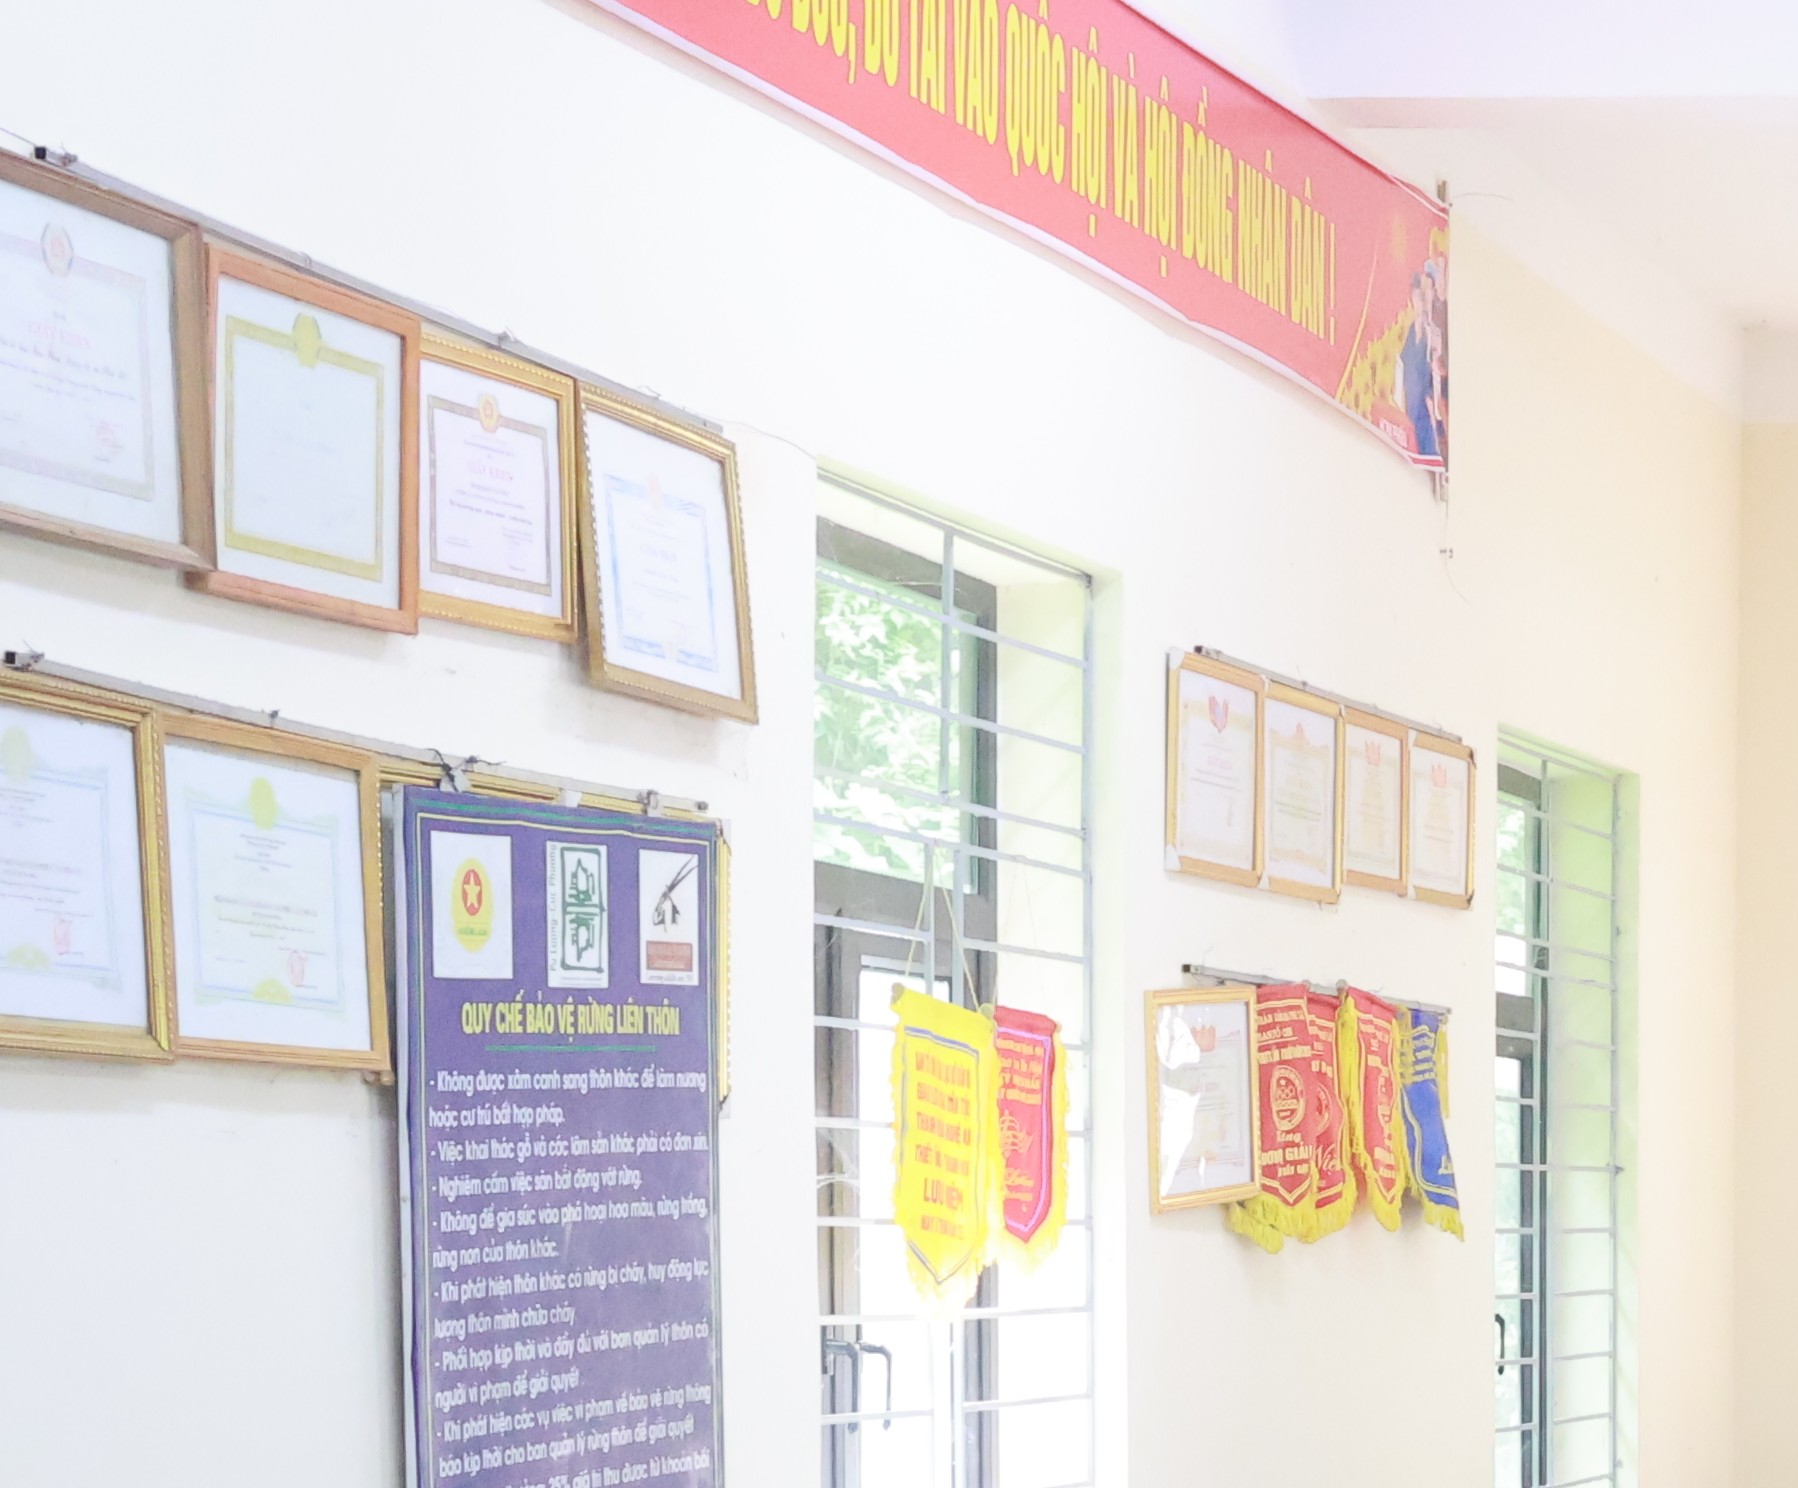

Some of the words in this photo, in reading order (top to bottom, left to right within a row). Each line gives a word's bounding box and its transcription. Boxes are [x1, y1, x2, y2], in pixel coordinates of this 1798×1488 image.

[1004, 0, 1066, 185] QUỐC
[1070, 25, 1108, 239] HỘI
[1112, 51, 1139, 229] VÀ
[1143, 74, 1178, 279] HỘI
[1181, 85, 1234, 285] ĐỒNG
[1237, 148, 1287, 317] NHÂN
[1290, 176, 1325, 341] DÂN
[461, 1002, 493, 1034] QUY
[495, 989, 525, 1034] CHẾ
[525, 990, 555, 1034] BẢO
[556, 995, 575, 1043] VỆ
[577, 995, 614, 1035] RỪNG
[616, 996, 644, 1035] LIÊN
[645, 998, 681, 1035] THÔN
[437, 1070, 474, 1097] Không
